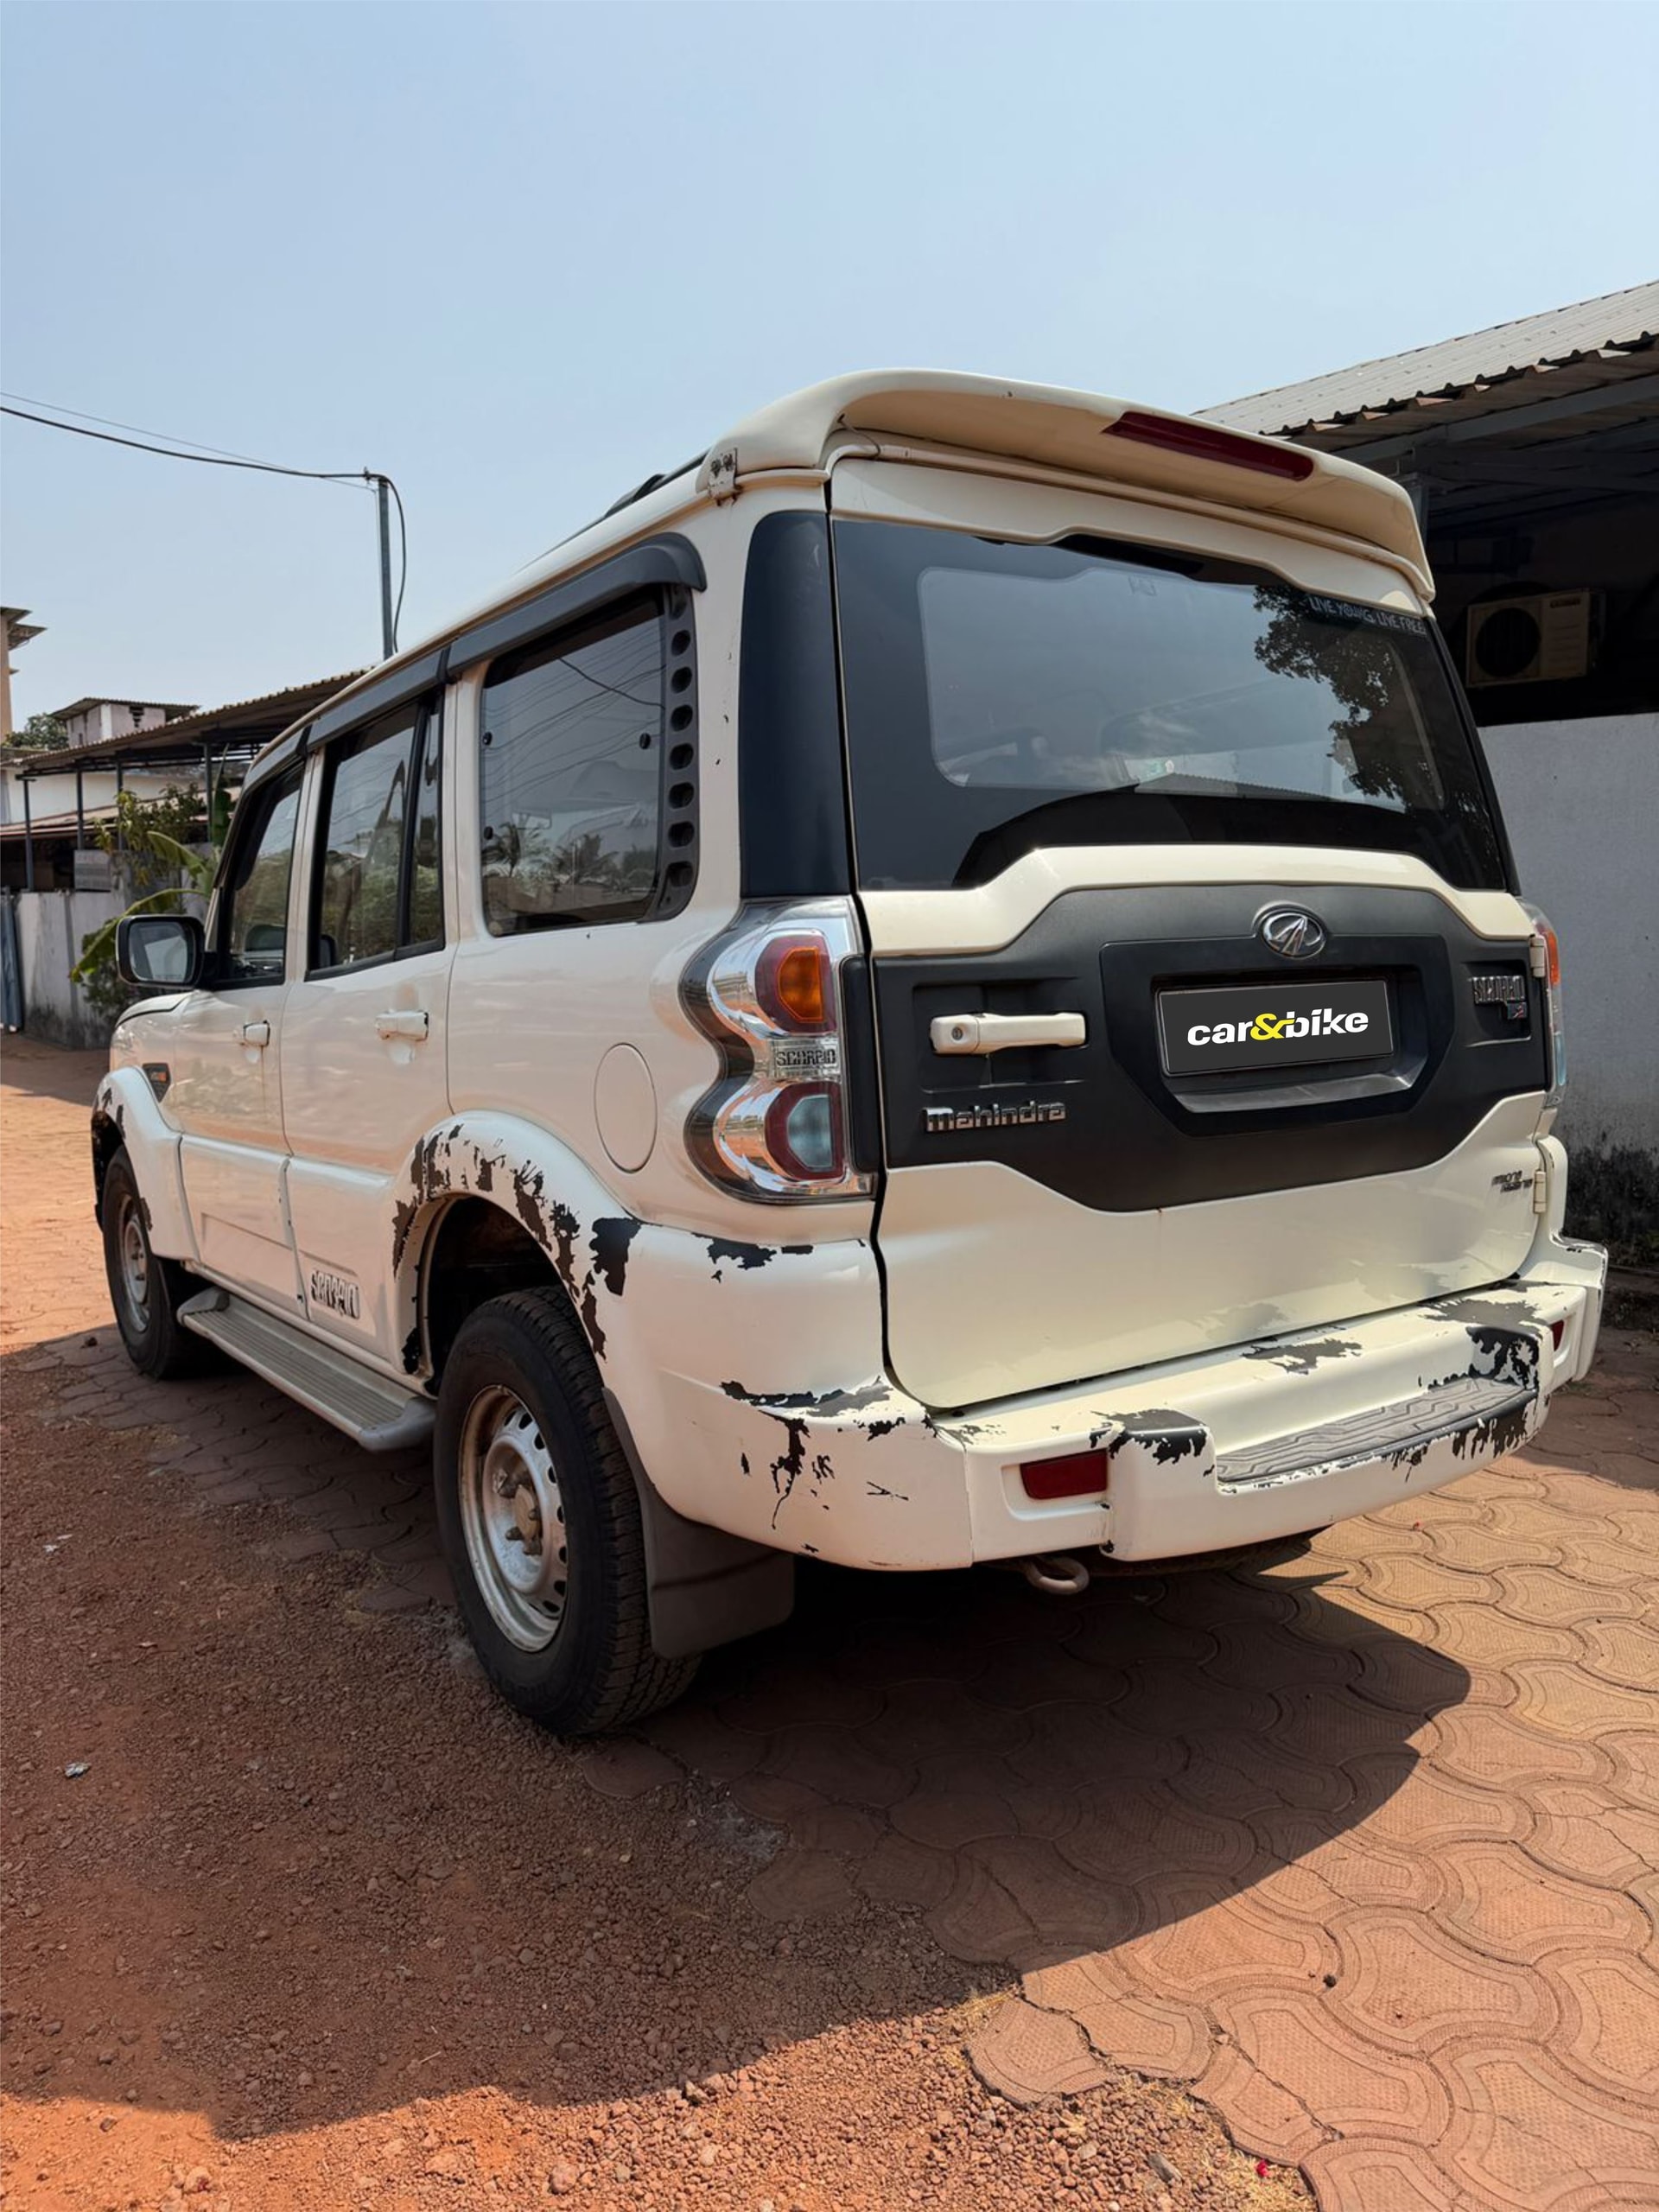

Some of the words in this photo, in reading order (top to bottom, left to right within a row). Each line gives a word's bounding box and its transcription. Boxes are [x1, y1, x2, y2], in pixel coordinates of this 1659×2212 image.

[1308, 596, 1336, 613] LIVE
[1376, 612, 1400, 628] LIVE
[1399, 617, 1427, 635] FREE
[777, 1048, 836, 1066] SCORPIO
[922, 1100, 1066, 1132] mahindra
